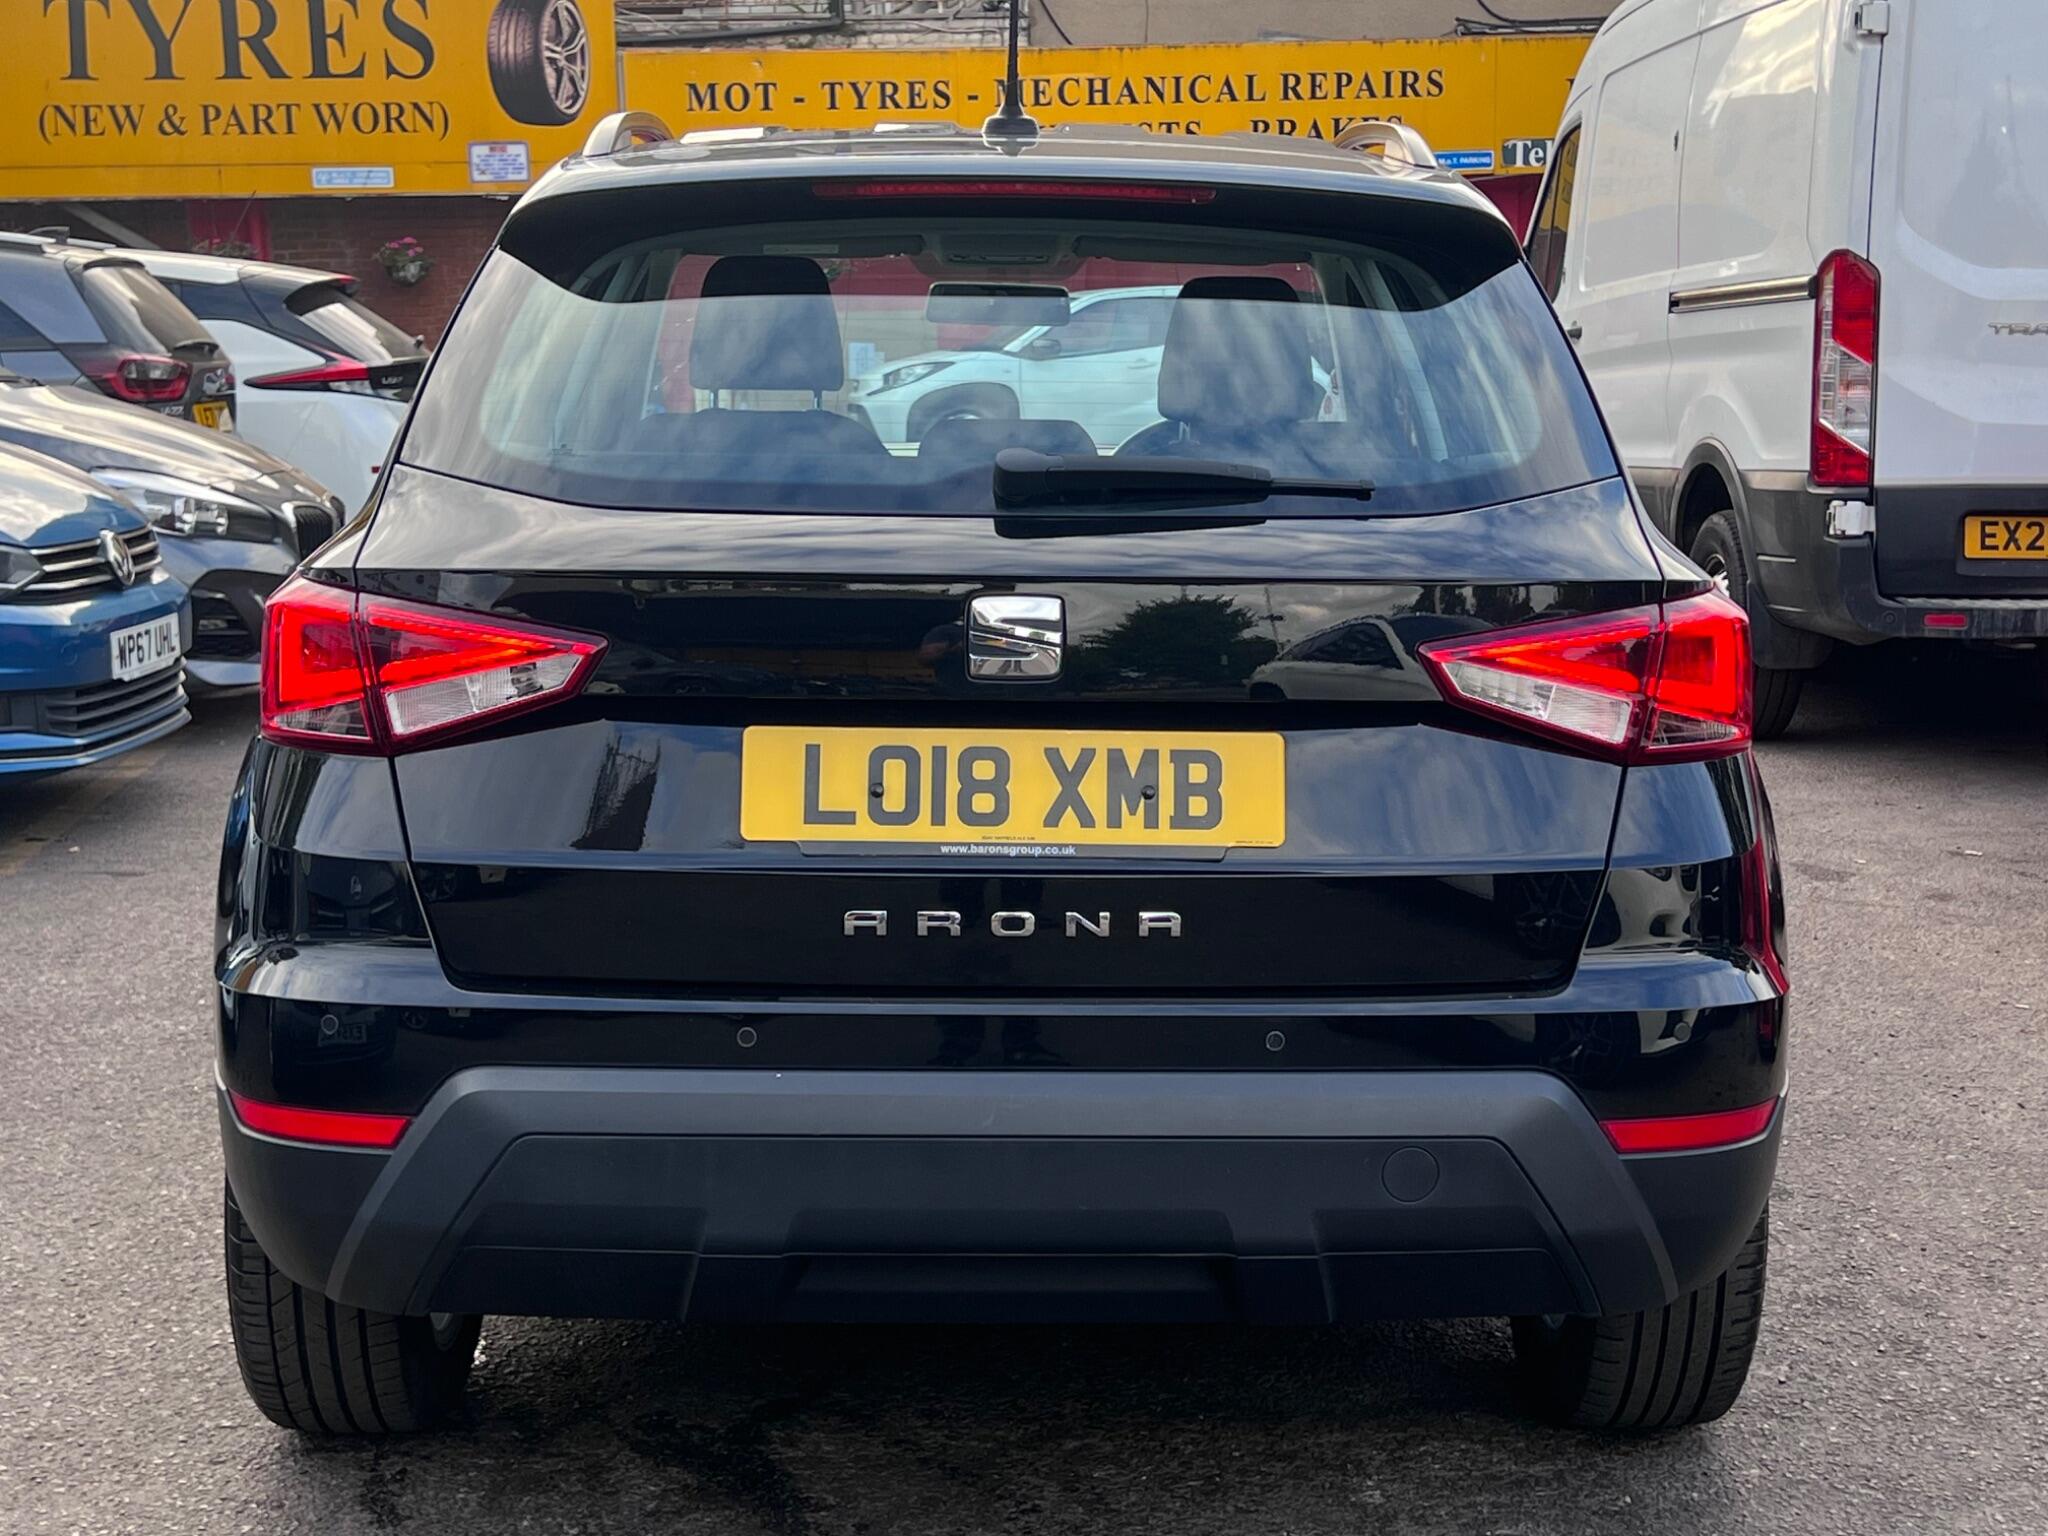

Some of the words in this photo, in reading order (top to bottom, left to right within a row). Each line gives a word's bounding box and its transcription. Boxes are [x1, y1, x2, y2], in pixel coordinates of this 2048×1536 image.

[42, 0, 436, 81] TYRES
[686, 82, 778, 112] MOT
[821, 80, 952, 110] TYRES
[994, 75, 1266, 107] MECHANICAL
[1279, 68, 1445, 101] REPAIRS
[38, 101, 145, 143] (NEW
[158, 104, 190, 137] &
[200, 102, 300, 137] PART
[314, 100, 451, 141] WORN)
[1250, 115, 1402, 140] RAK
[1980, 521, 2045, 551] EX2
[118, 629, 151, 669] WP67
[154, 622, 176, 656] UHL
[803, 743, 1011, 828] LO18
[1042, 746, 1223, 831] XMB
[940, 843, 1077, 857] www.baronsgroup.co.uk
[843, 909, 1182, 938] ARONA
